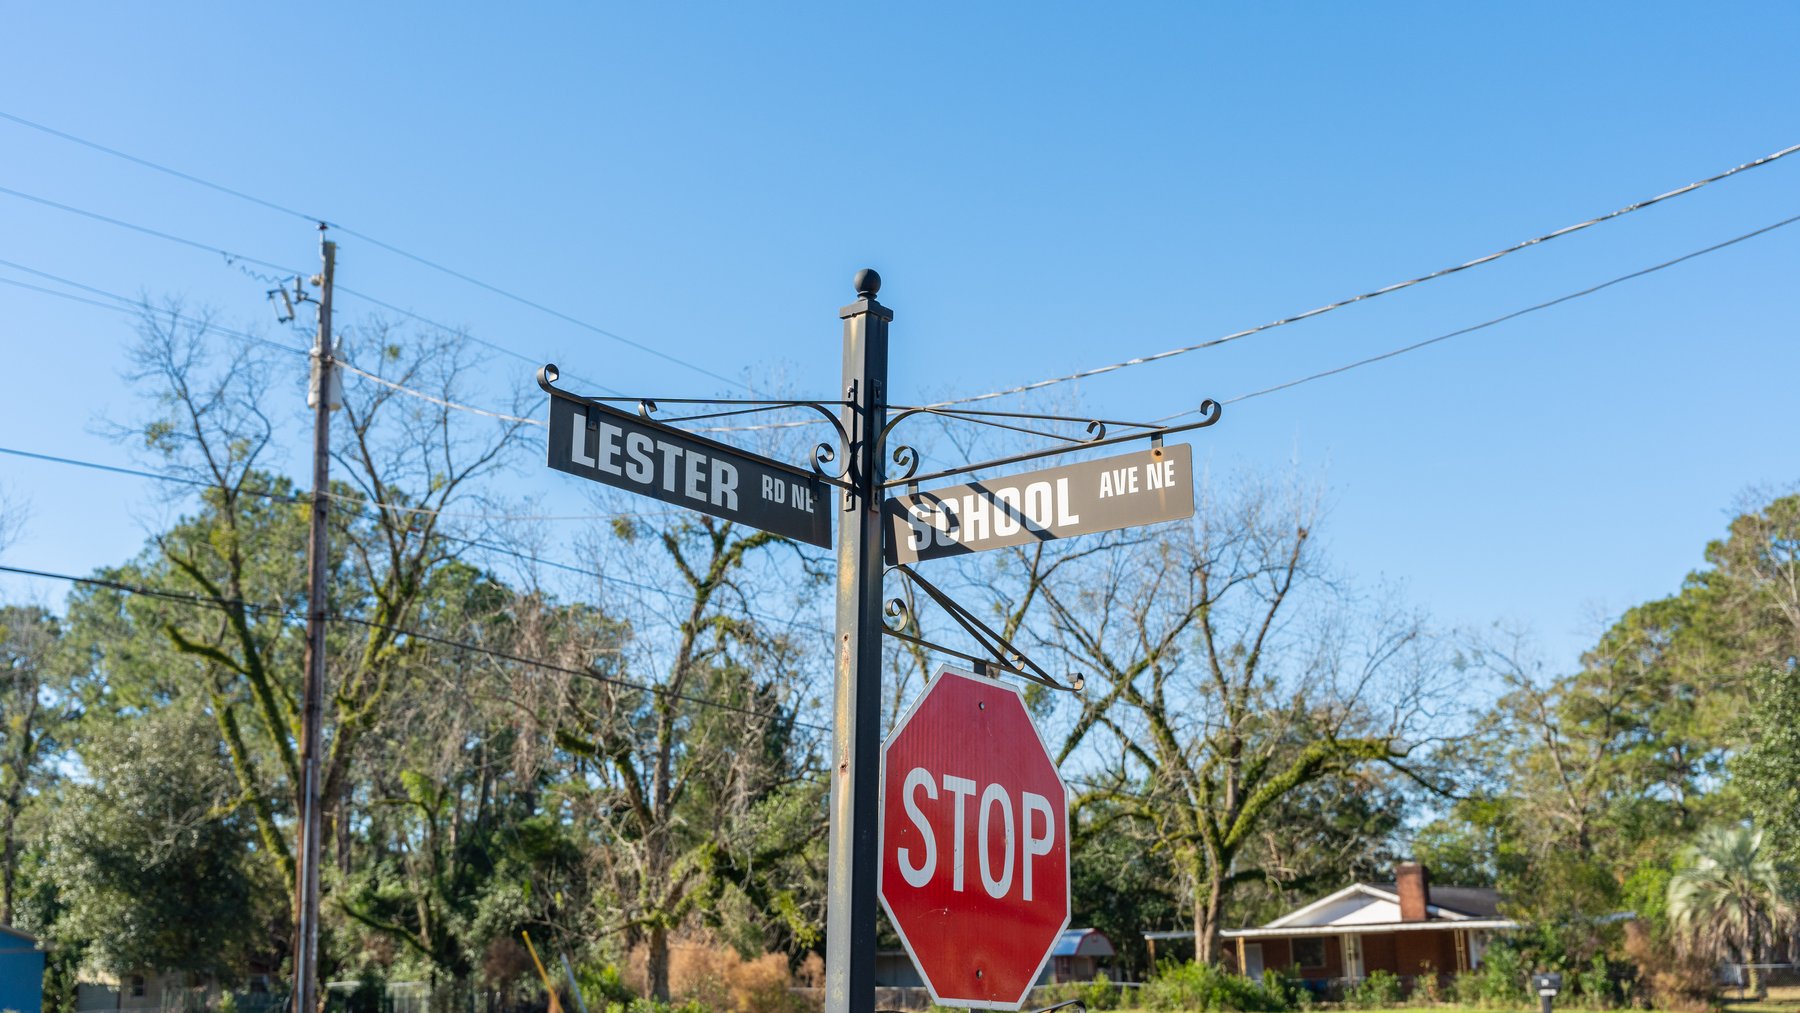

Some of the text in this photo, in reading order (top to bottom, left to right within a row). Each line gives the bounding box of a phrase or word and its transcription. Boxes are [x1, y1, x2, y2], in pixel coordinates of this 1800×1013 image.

[571, 413, 815, 513] LESTER RD NE
[907, 459, 1176, 551] SCHOOL AVE NE
[897, 767, 1055, 902] STOP
